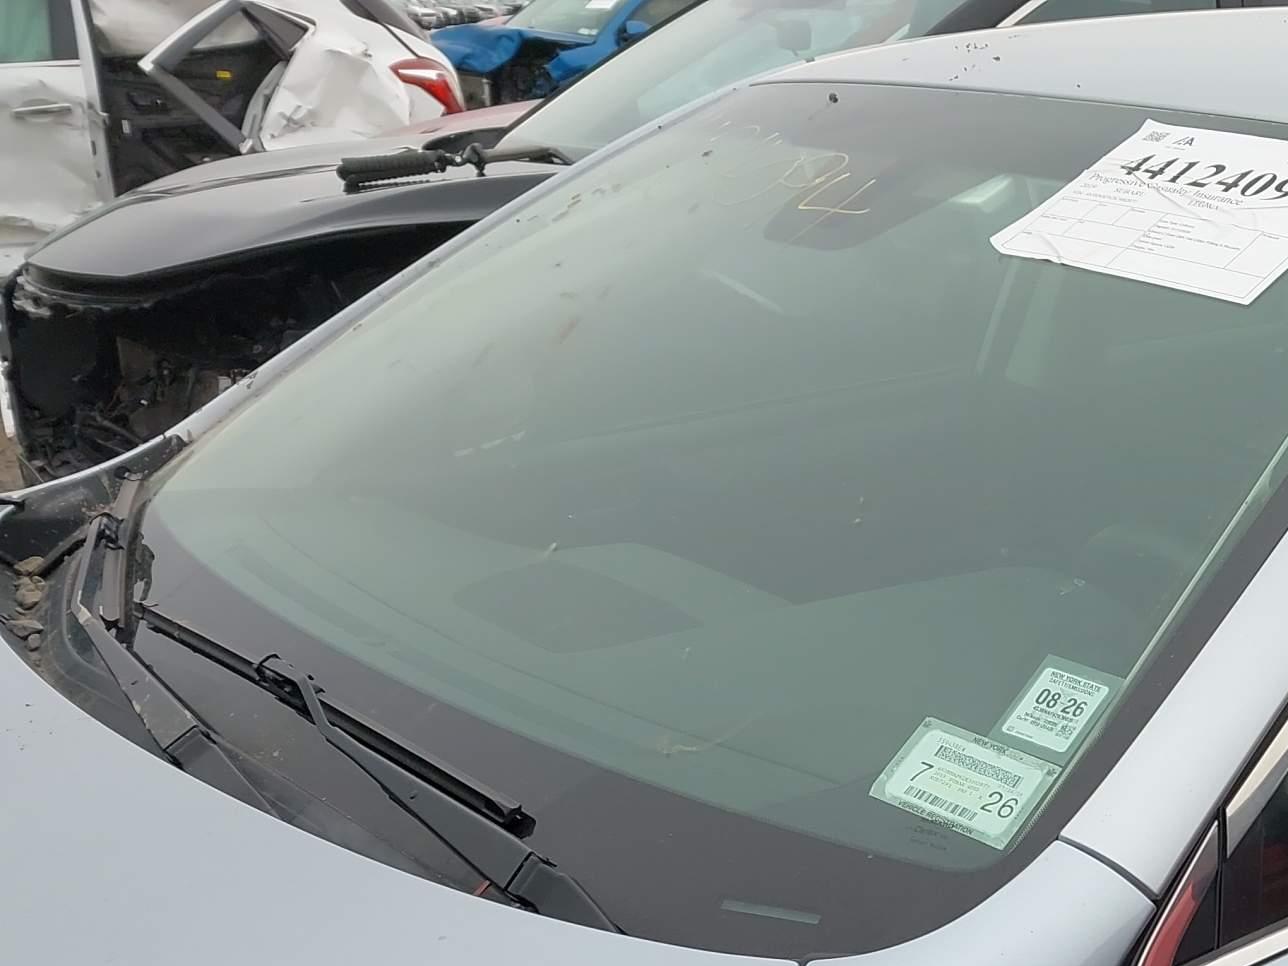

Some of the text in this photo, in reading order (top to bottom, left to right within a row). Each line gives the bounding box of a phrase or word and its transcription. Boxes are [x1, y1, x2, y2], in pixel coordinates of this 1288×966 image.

[1193, 190, 1243, 206] Insurance
[973, 737, 989, 749] NEW
[990, 742, 1009, 755] YORK
[909, 761, 934, 782] 7
[979, 791, 1019, 818] 26
